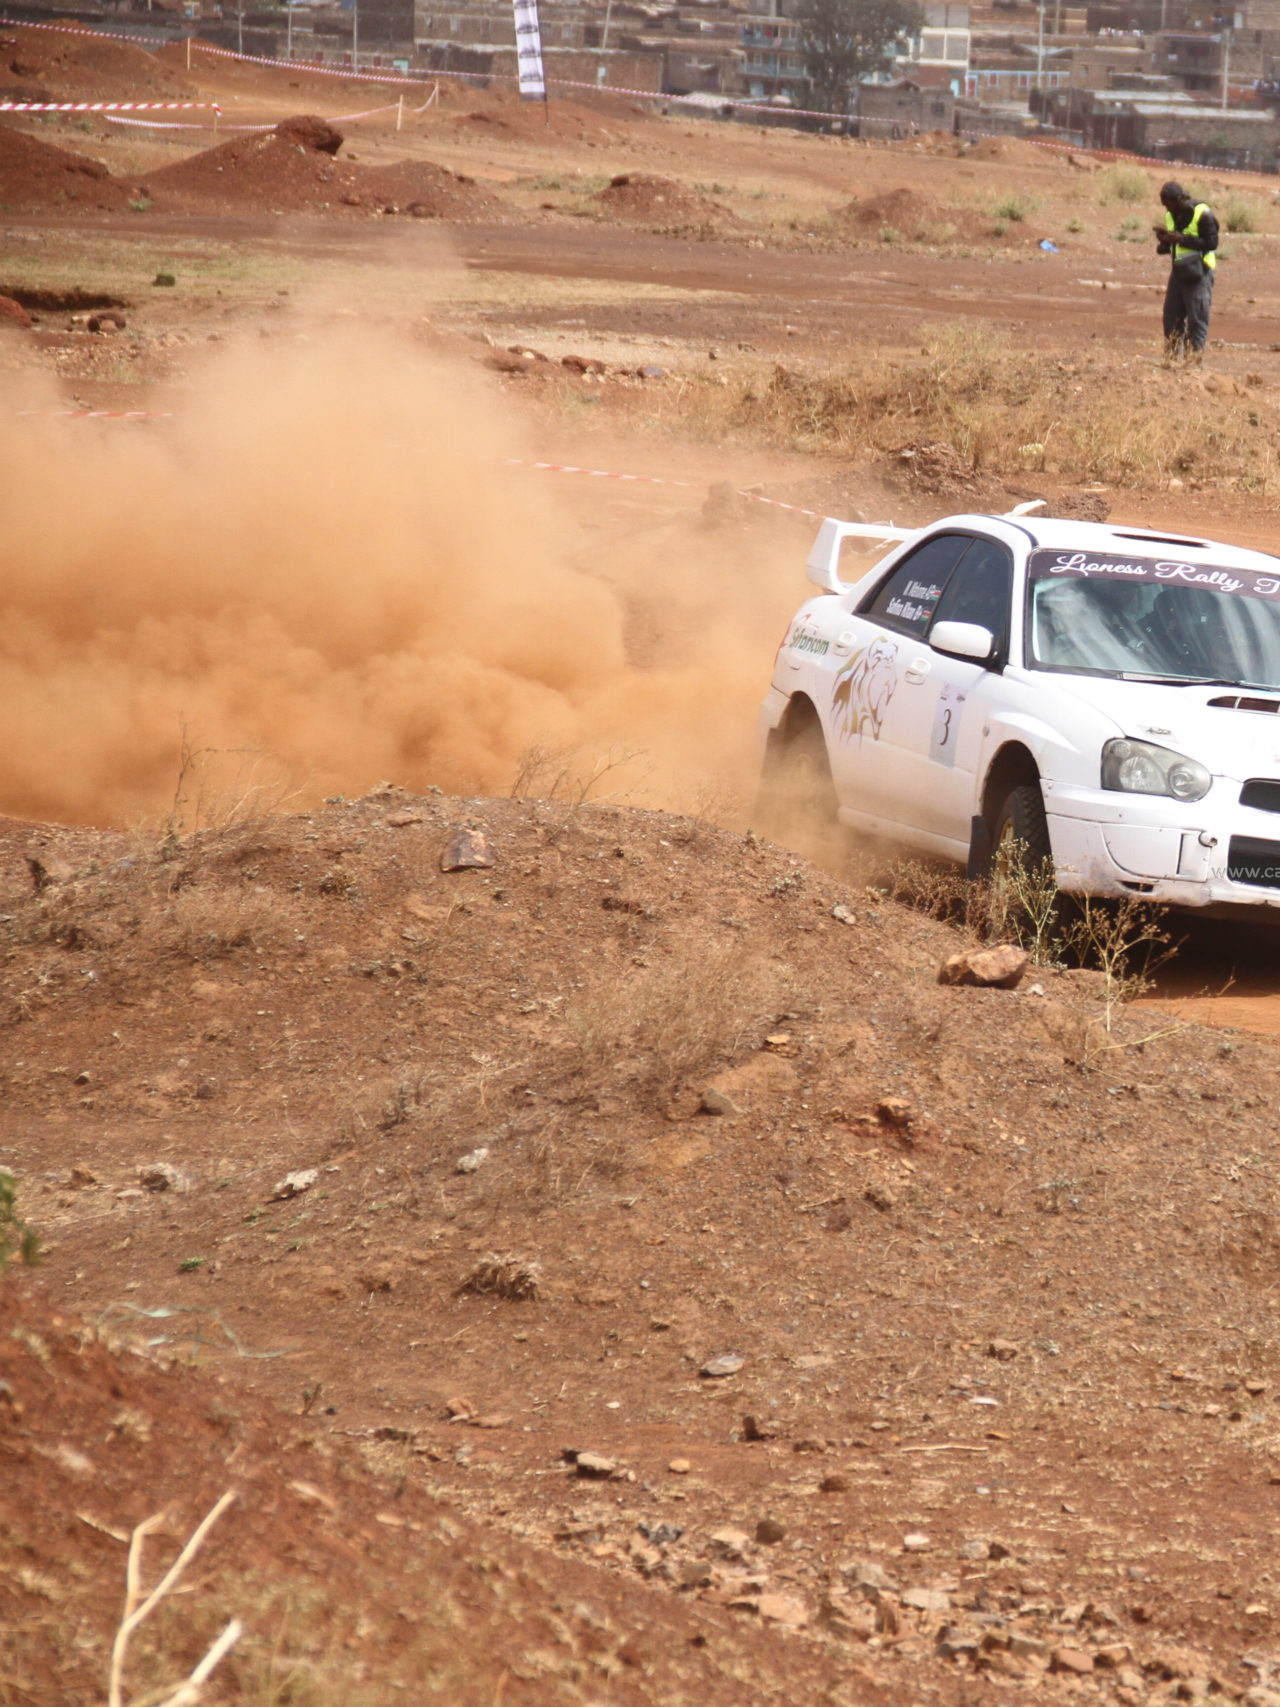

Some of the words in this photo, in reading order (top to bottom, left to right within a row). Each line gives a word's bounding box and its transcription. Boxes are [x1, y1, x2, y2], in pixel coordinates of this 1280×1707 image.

[1050, 553, 1148, 577] Lioness
[1154, 561, 1244, 591] Rally
[939, 708, 952, 746] 3
